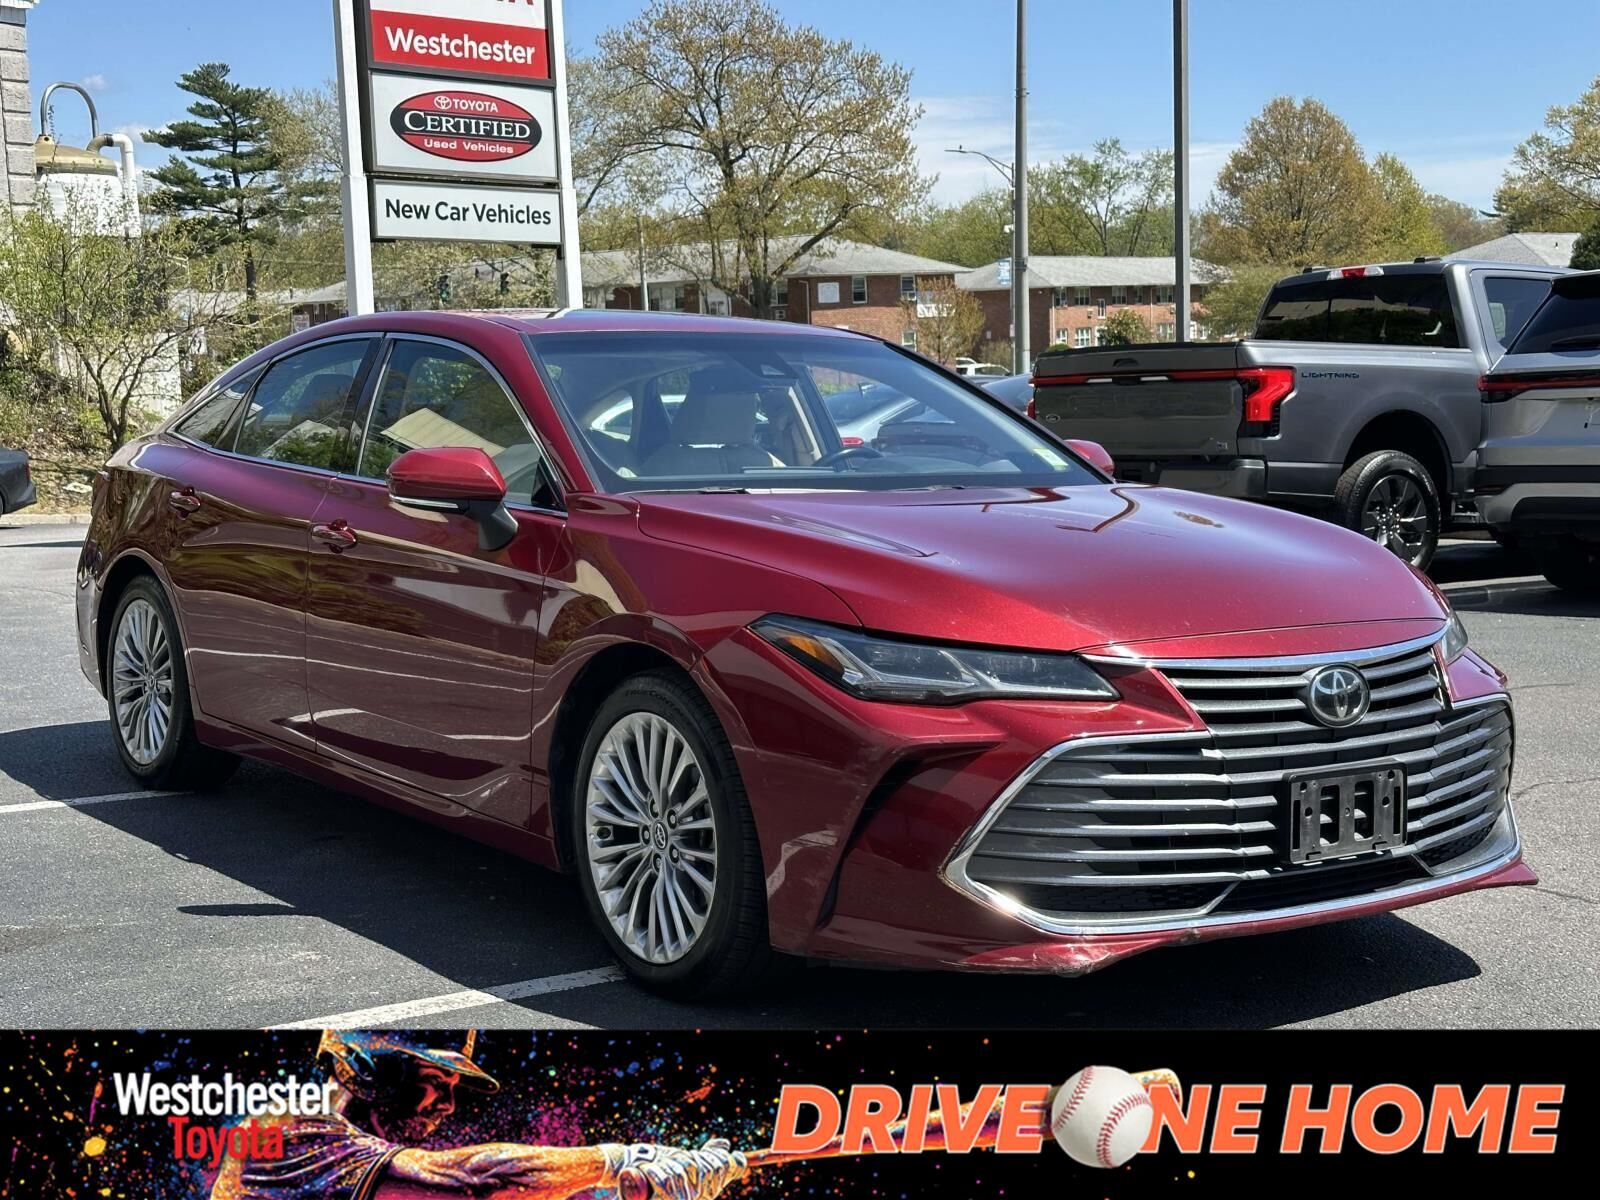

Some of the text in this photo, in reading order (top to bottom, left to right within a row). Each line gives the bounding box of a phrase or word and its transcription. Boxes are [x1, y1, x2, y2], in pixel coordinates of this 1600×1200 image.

[385, 26, 535, 64] Westchester
[452, 98, 499, 113] TOYOTA
[404, 110, 531, 138] CERTIFIED
[423, 138, 514, 154] Used Vehicles
[385, 198, 551, 225] New Car Vehicles
